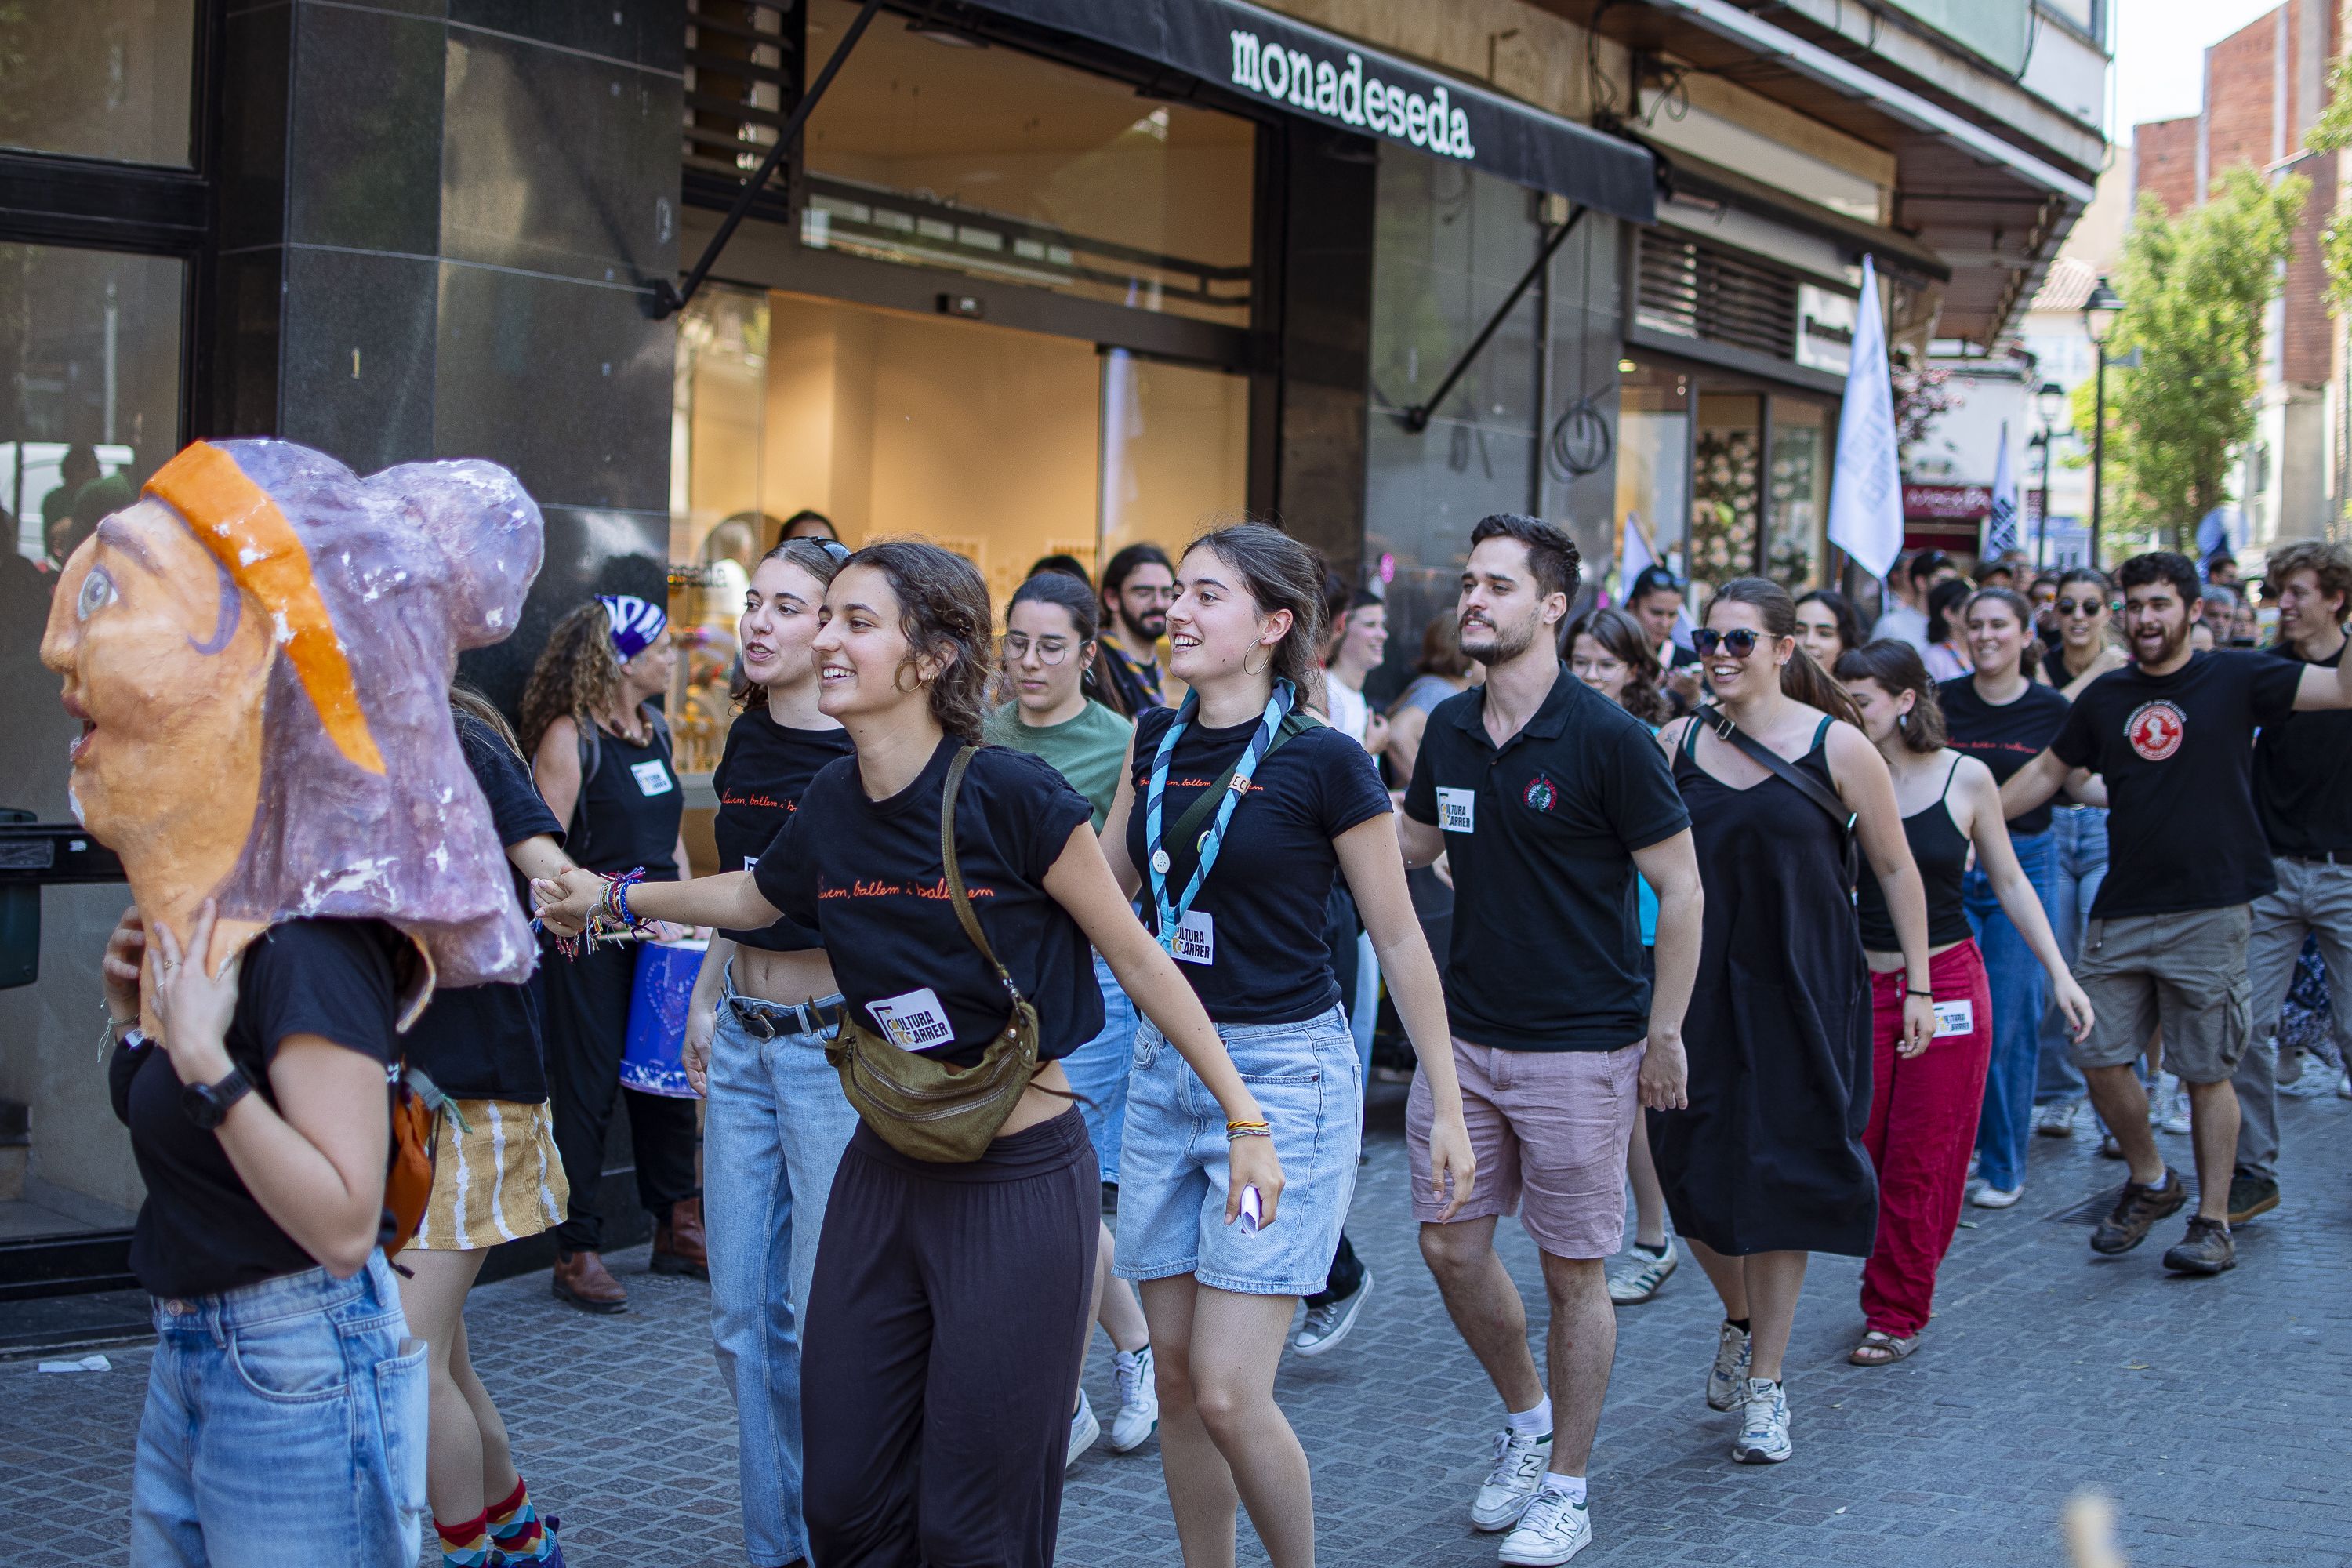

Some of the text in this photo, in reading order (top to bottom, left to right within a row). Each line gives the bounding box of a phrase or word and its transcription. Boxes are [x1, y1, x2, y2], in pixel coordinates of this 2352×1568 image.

[1230, 29, 1475, 160] monadeseda
[1181, 778, 1211, 787] ballem
[750, 793, 777, 807] ballem
[854, 880, 900, 897] ballem
[906, 882, 913, 895] i
[916, 877, 994, 899] ballem
[1176, 927, 1205, 944] ULTURA
[887, 1011, 935, 1032] CULTURA
